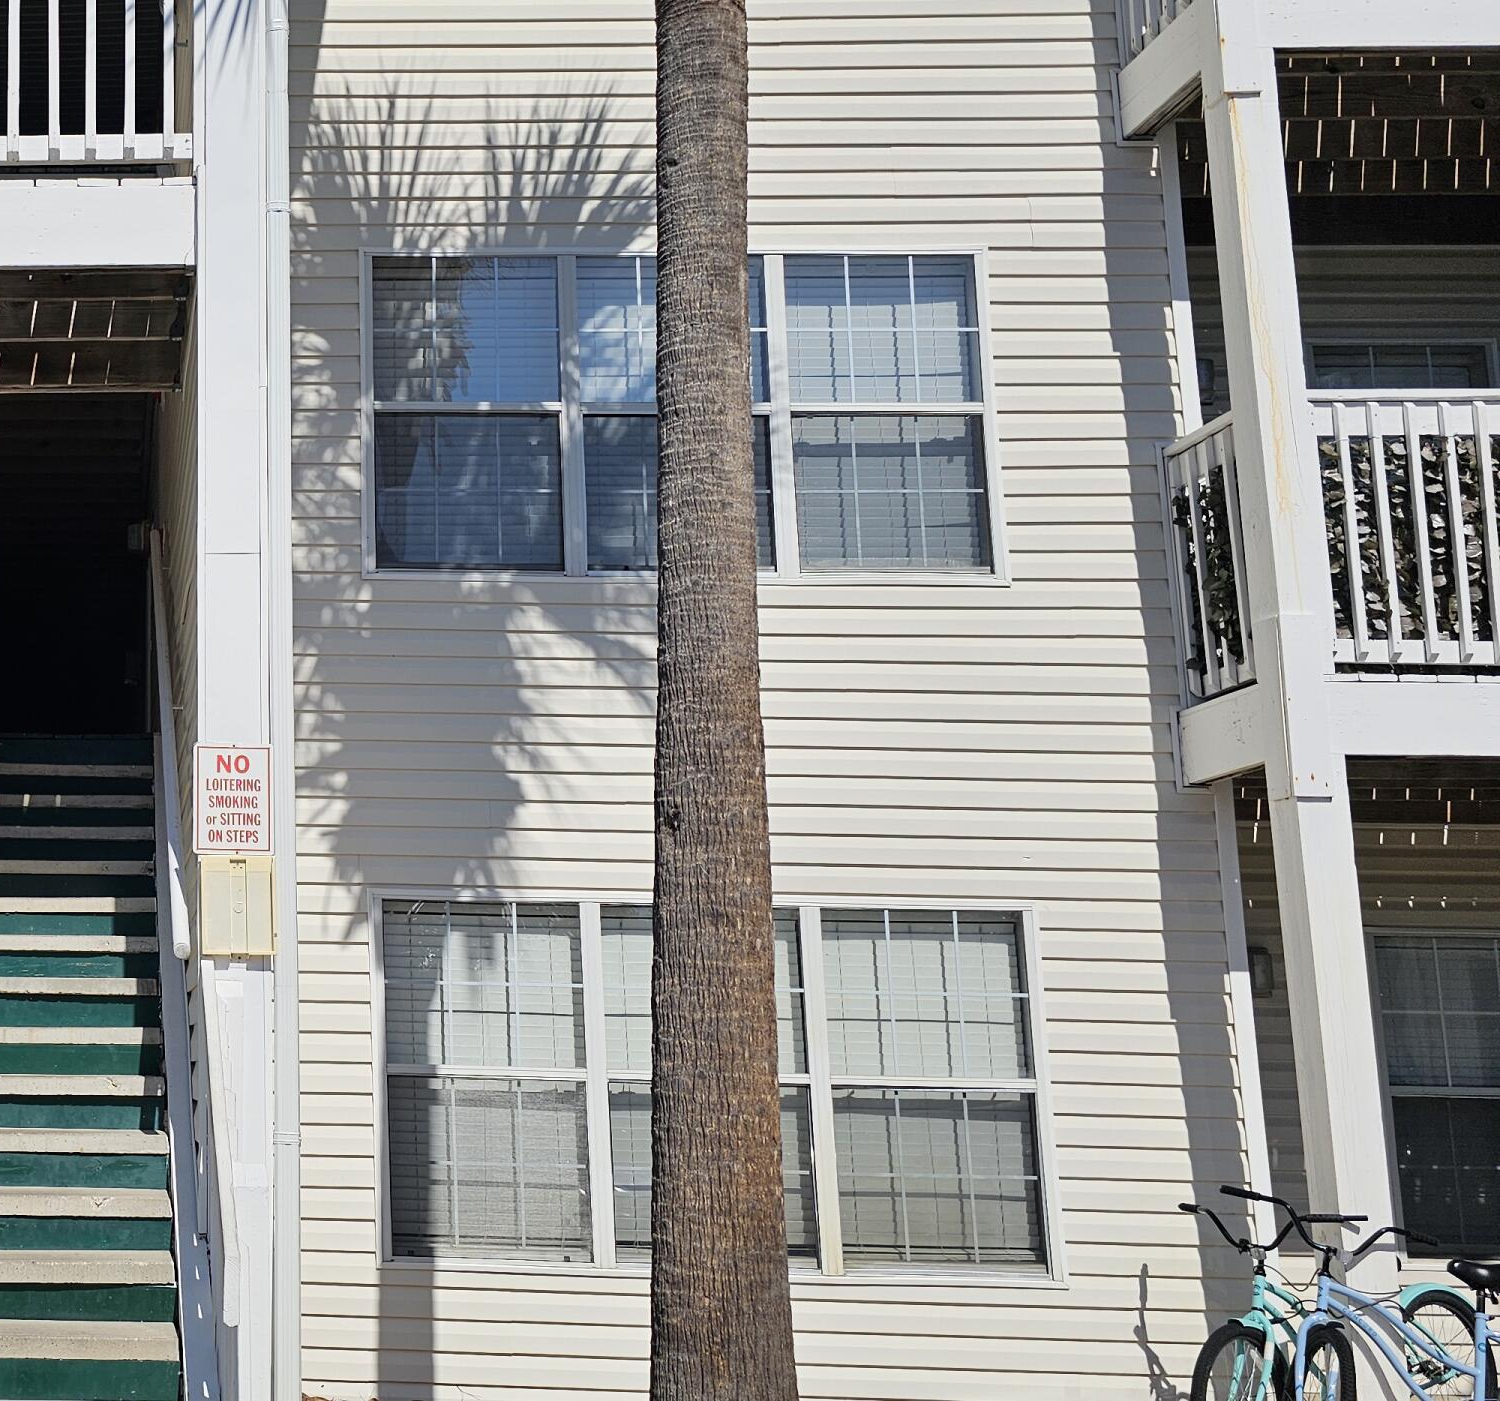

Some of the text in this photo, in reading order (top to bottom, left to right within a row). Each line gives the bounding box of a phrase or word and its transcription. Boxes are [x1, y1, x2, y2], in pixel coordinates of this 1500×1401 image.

[216, 754, 250, 774] NO
[206, 778, 261, 791] LOITERING
[208, 796, 258, 808] SMOKING
[206, 813, 261, 826] or SITTING
[208, 830, 259, 843] ON STEPS
